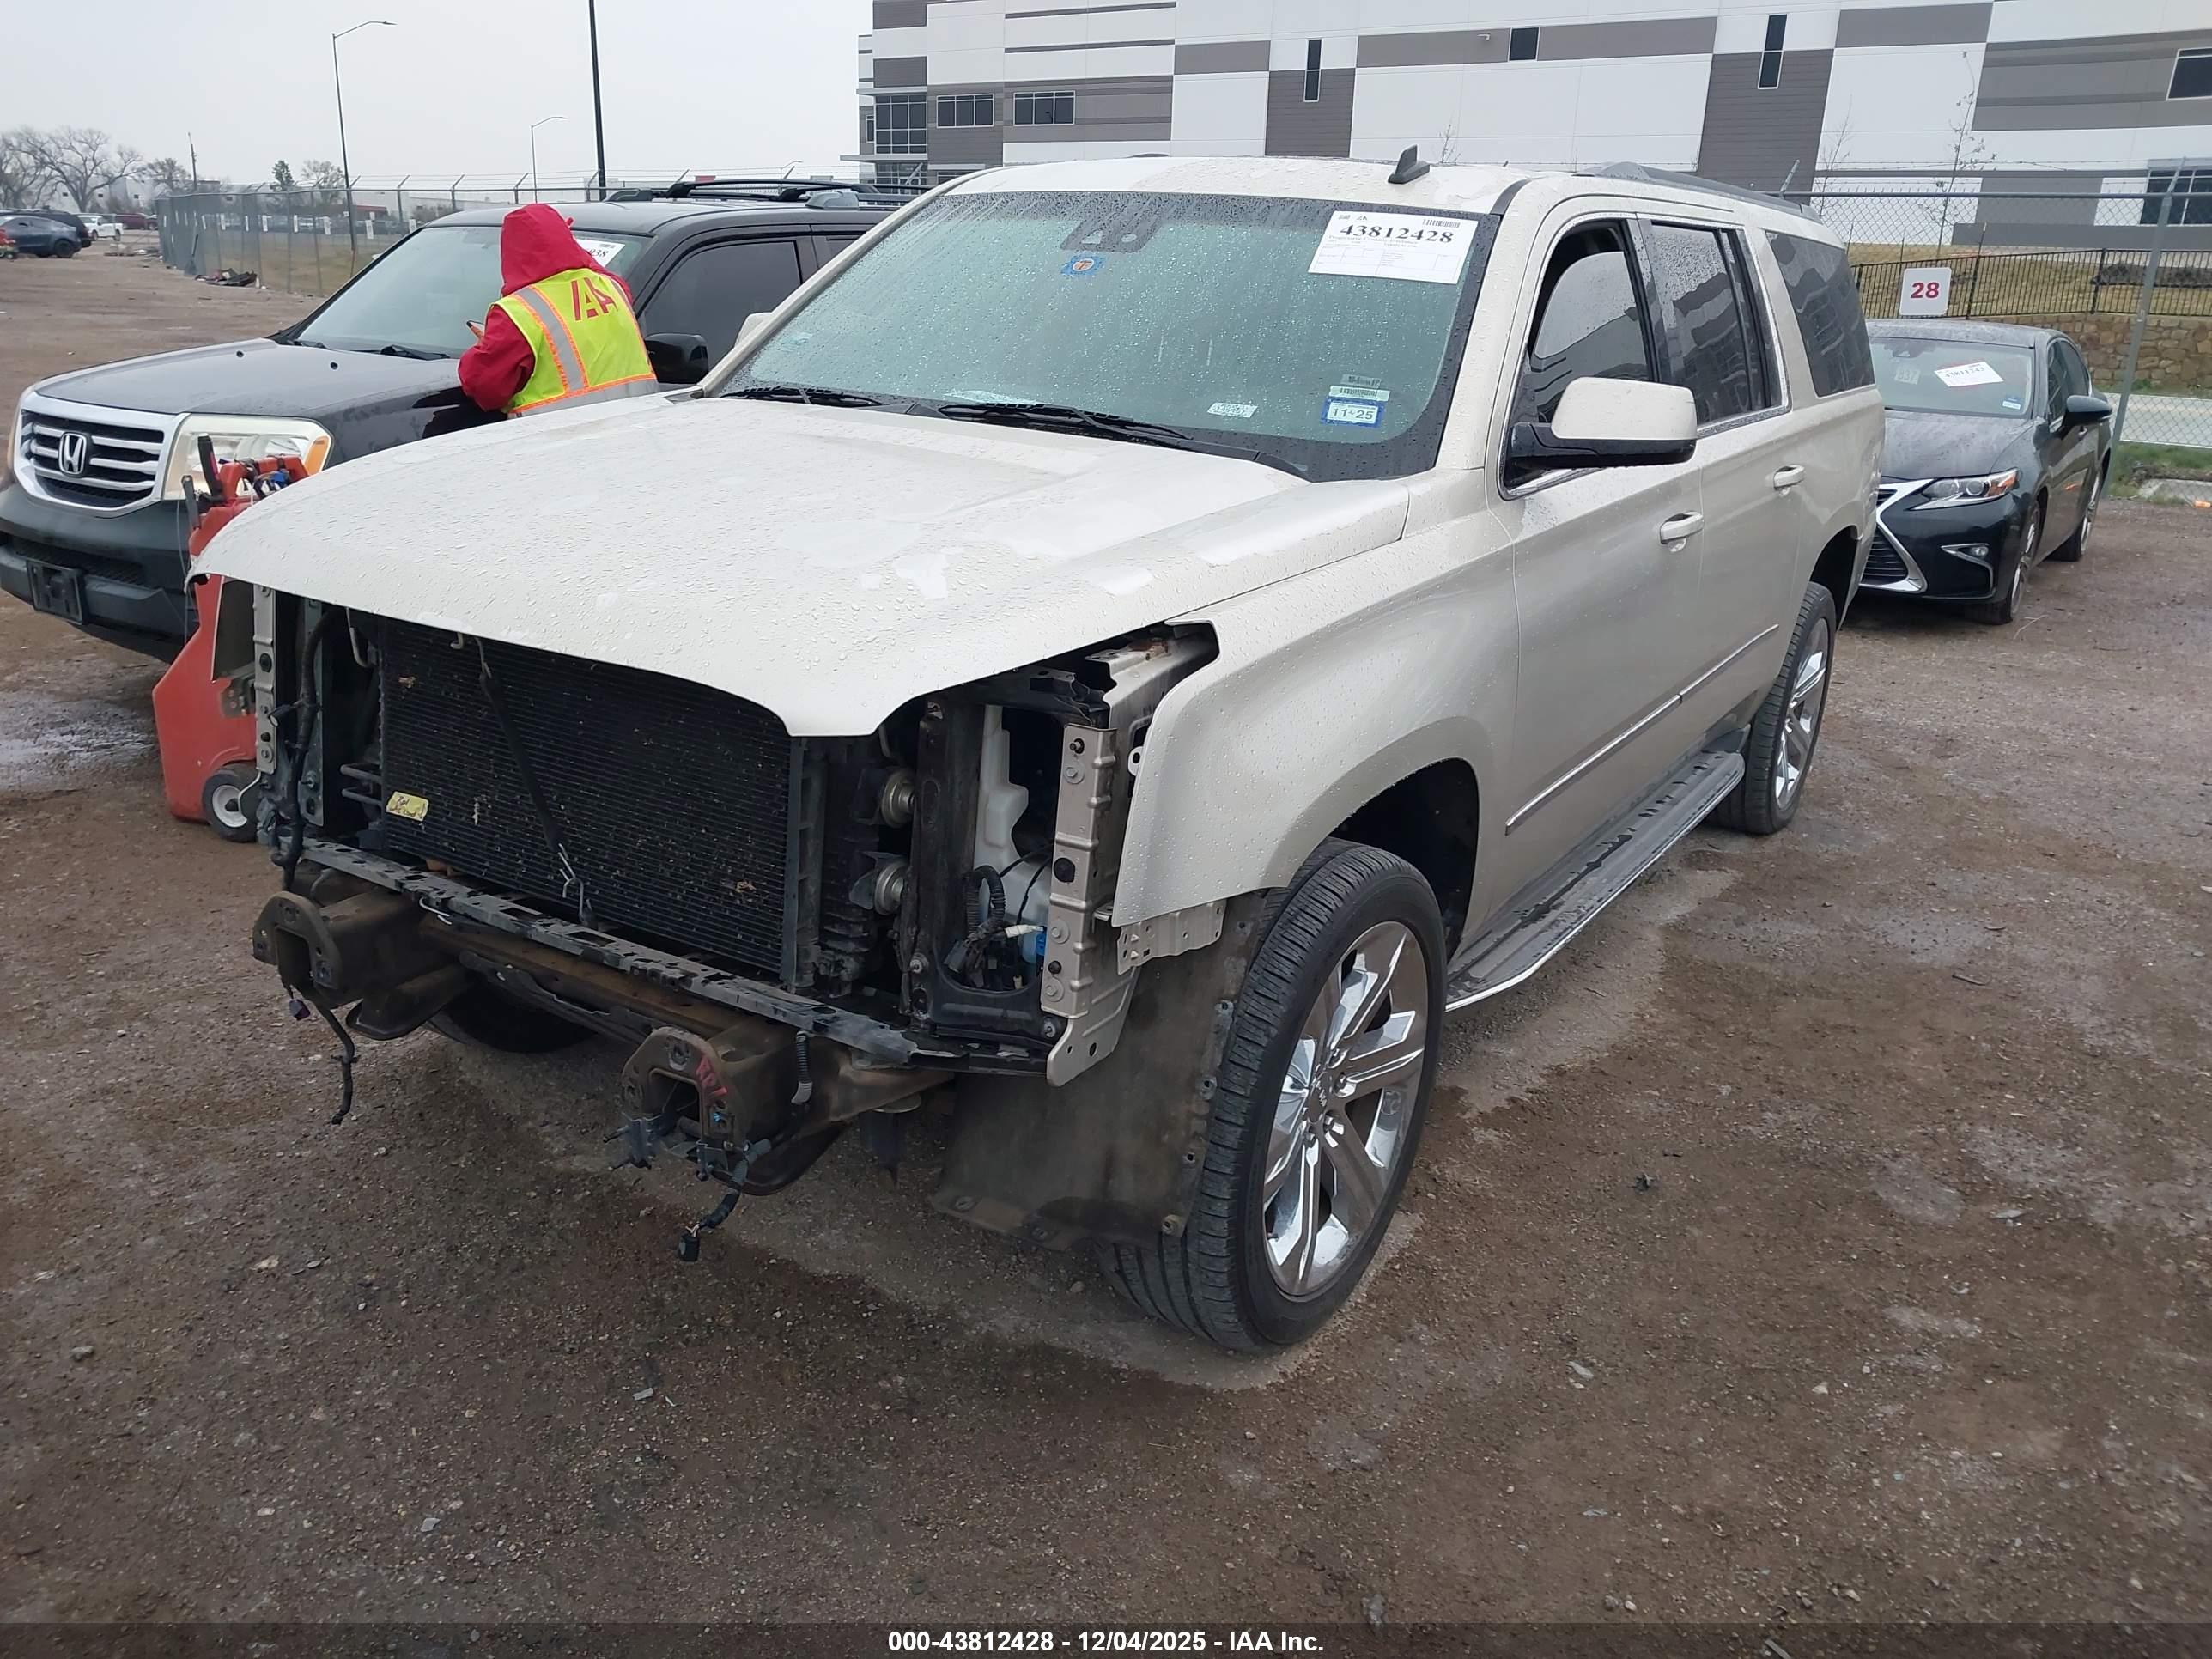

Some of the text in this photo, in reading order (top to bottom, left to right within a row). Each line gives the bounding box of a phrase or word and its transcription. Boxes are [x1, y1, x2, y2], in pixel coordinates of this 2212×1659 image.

[1340, 224, 1455, 244] 43812428
[1910, 282, 1940, 299] 28
[1332, 408, 1374, 420] 11 25
